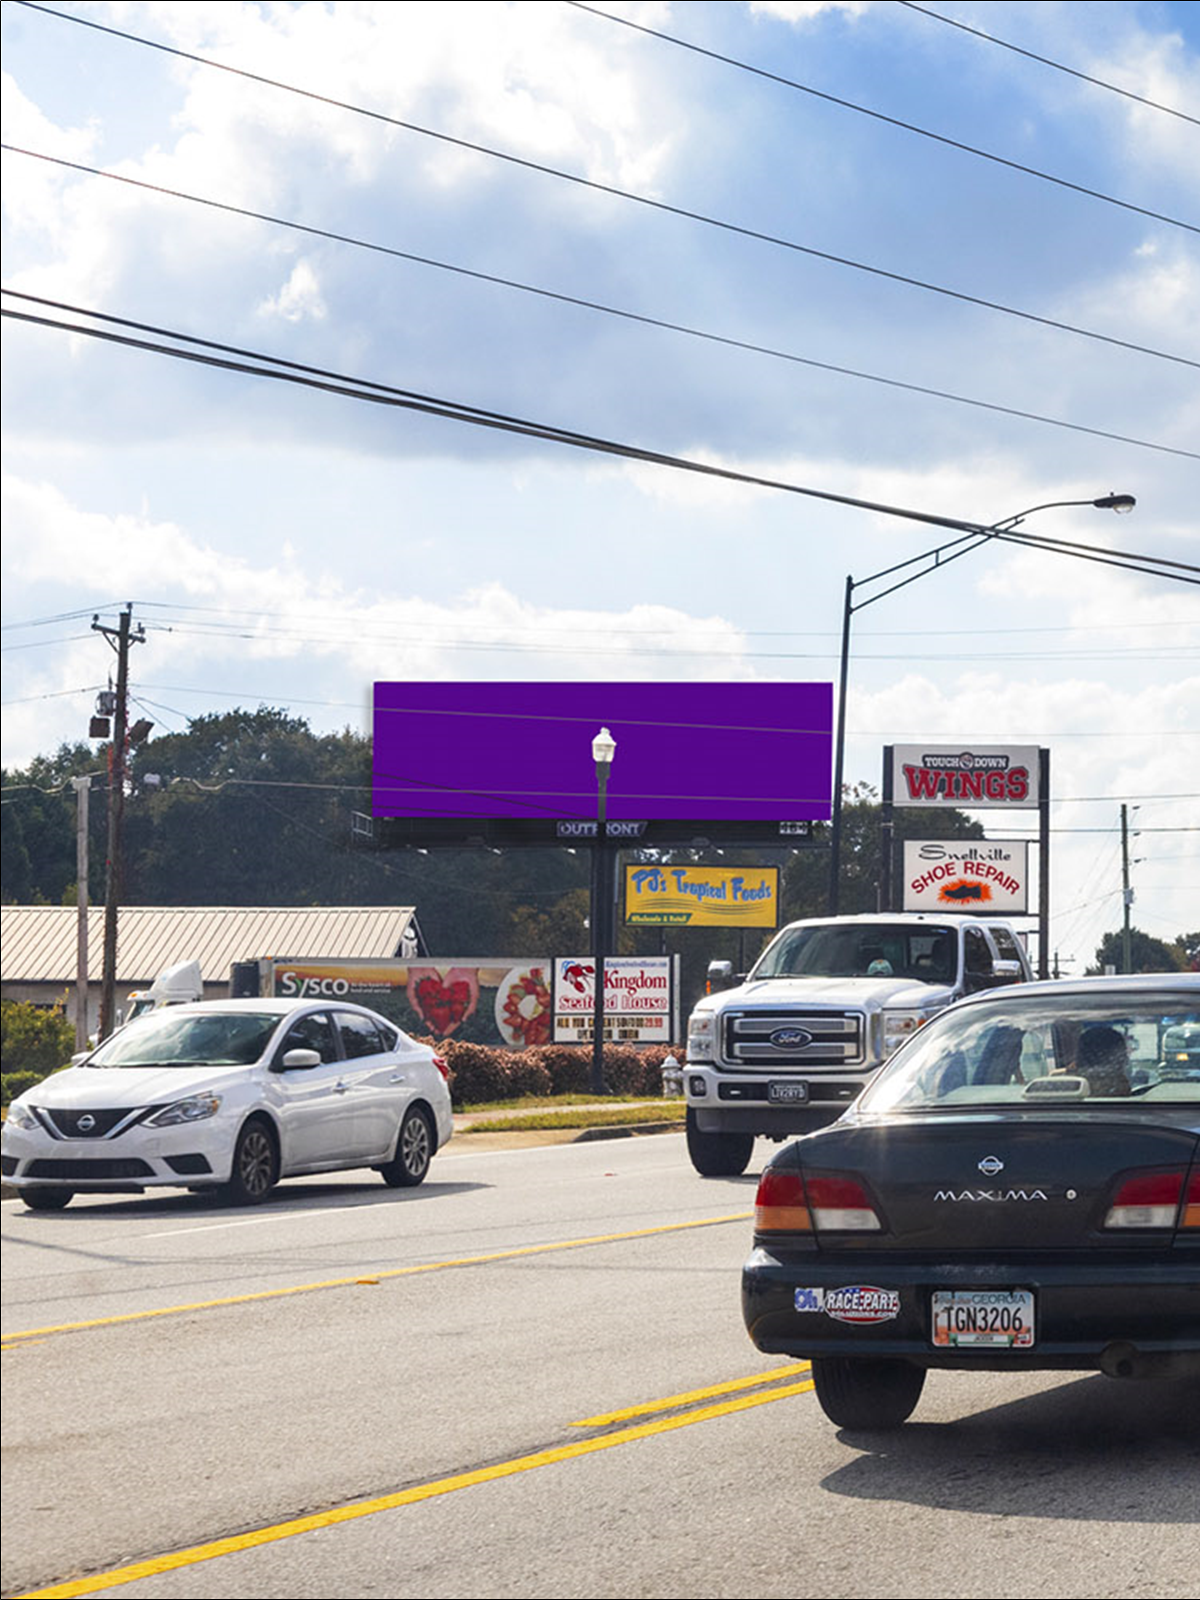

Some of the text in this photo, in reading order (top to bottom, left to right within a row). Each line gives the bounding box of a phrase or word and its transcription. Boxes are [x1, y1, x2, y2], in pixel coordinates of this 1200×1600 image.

[924, 757, 1007, 768] TOUCH DOWN
[903, 765, 1029, 800] WINGS
[918, 844, 1011, 861] Snellville
[671, 869, 727, 902] Tropical
[731, 877, 772, 902] Foods
[911, 861, 1020, 895] SHOE REPAIR
[604, 969, 667, 997] Kingdom
[621, 994, 667, 1011] House
[778, 1031, 802, 1044] Ford
[934, 1190, 1048, 1201] MAXIMA
[826, 1292, 860, 1310] RACE
[972, 1293, 1026, 1305] GEORGIA
[944, 1306, 1023, 1332] TGN3206
